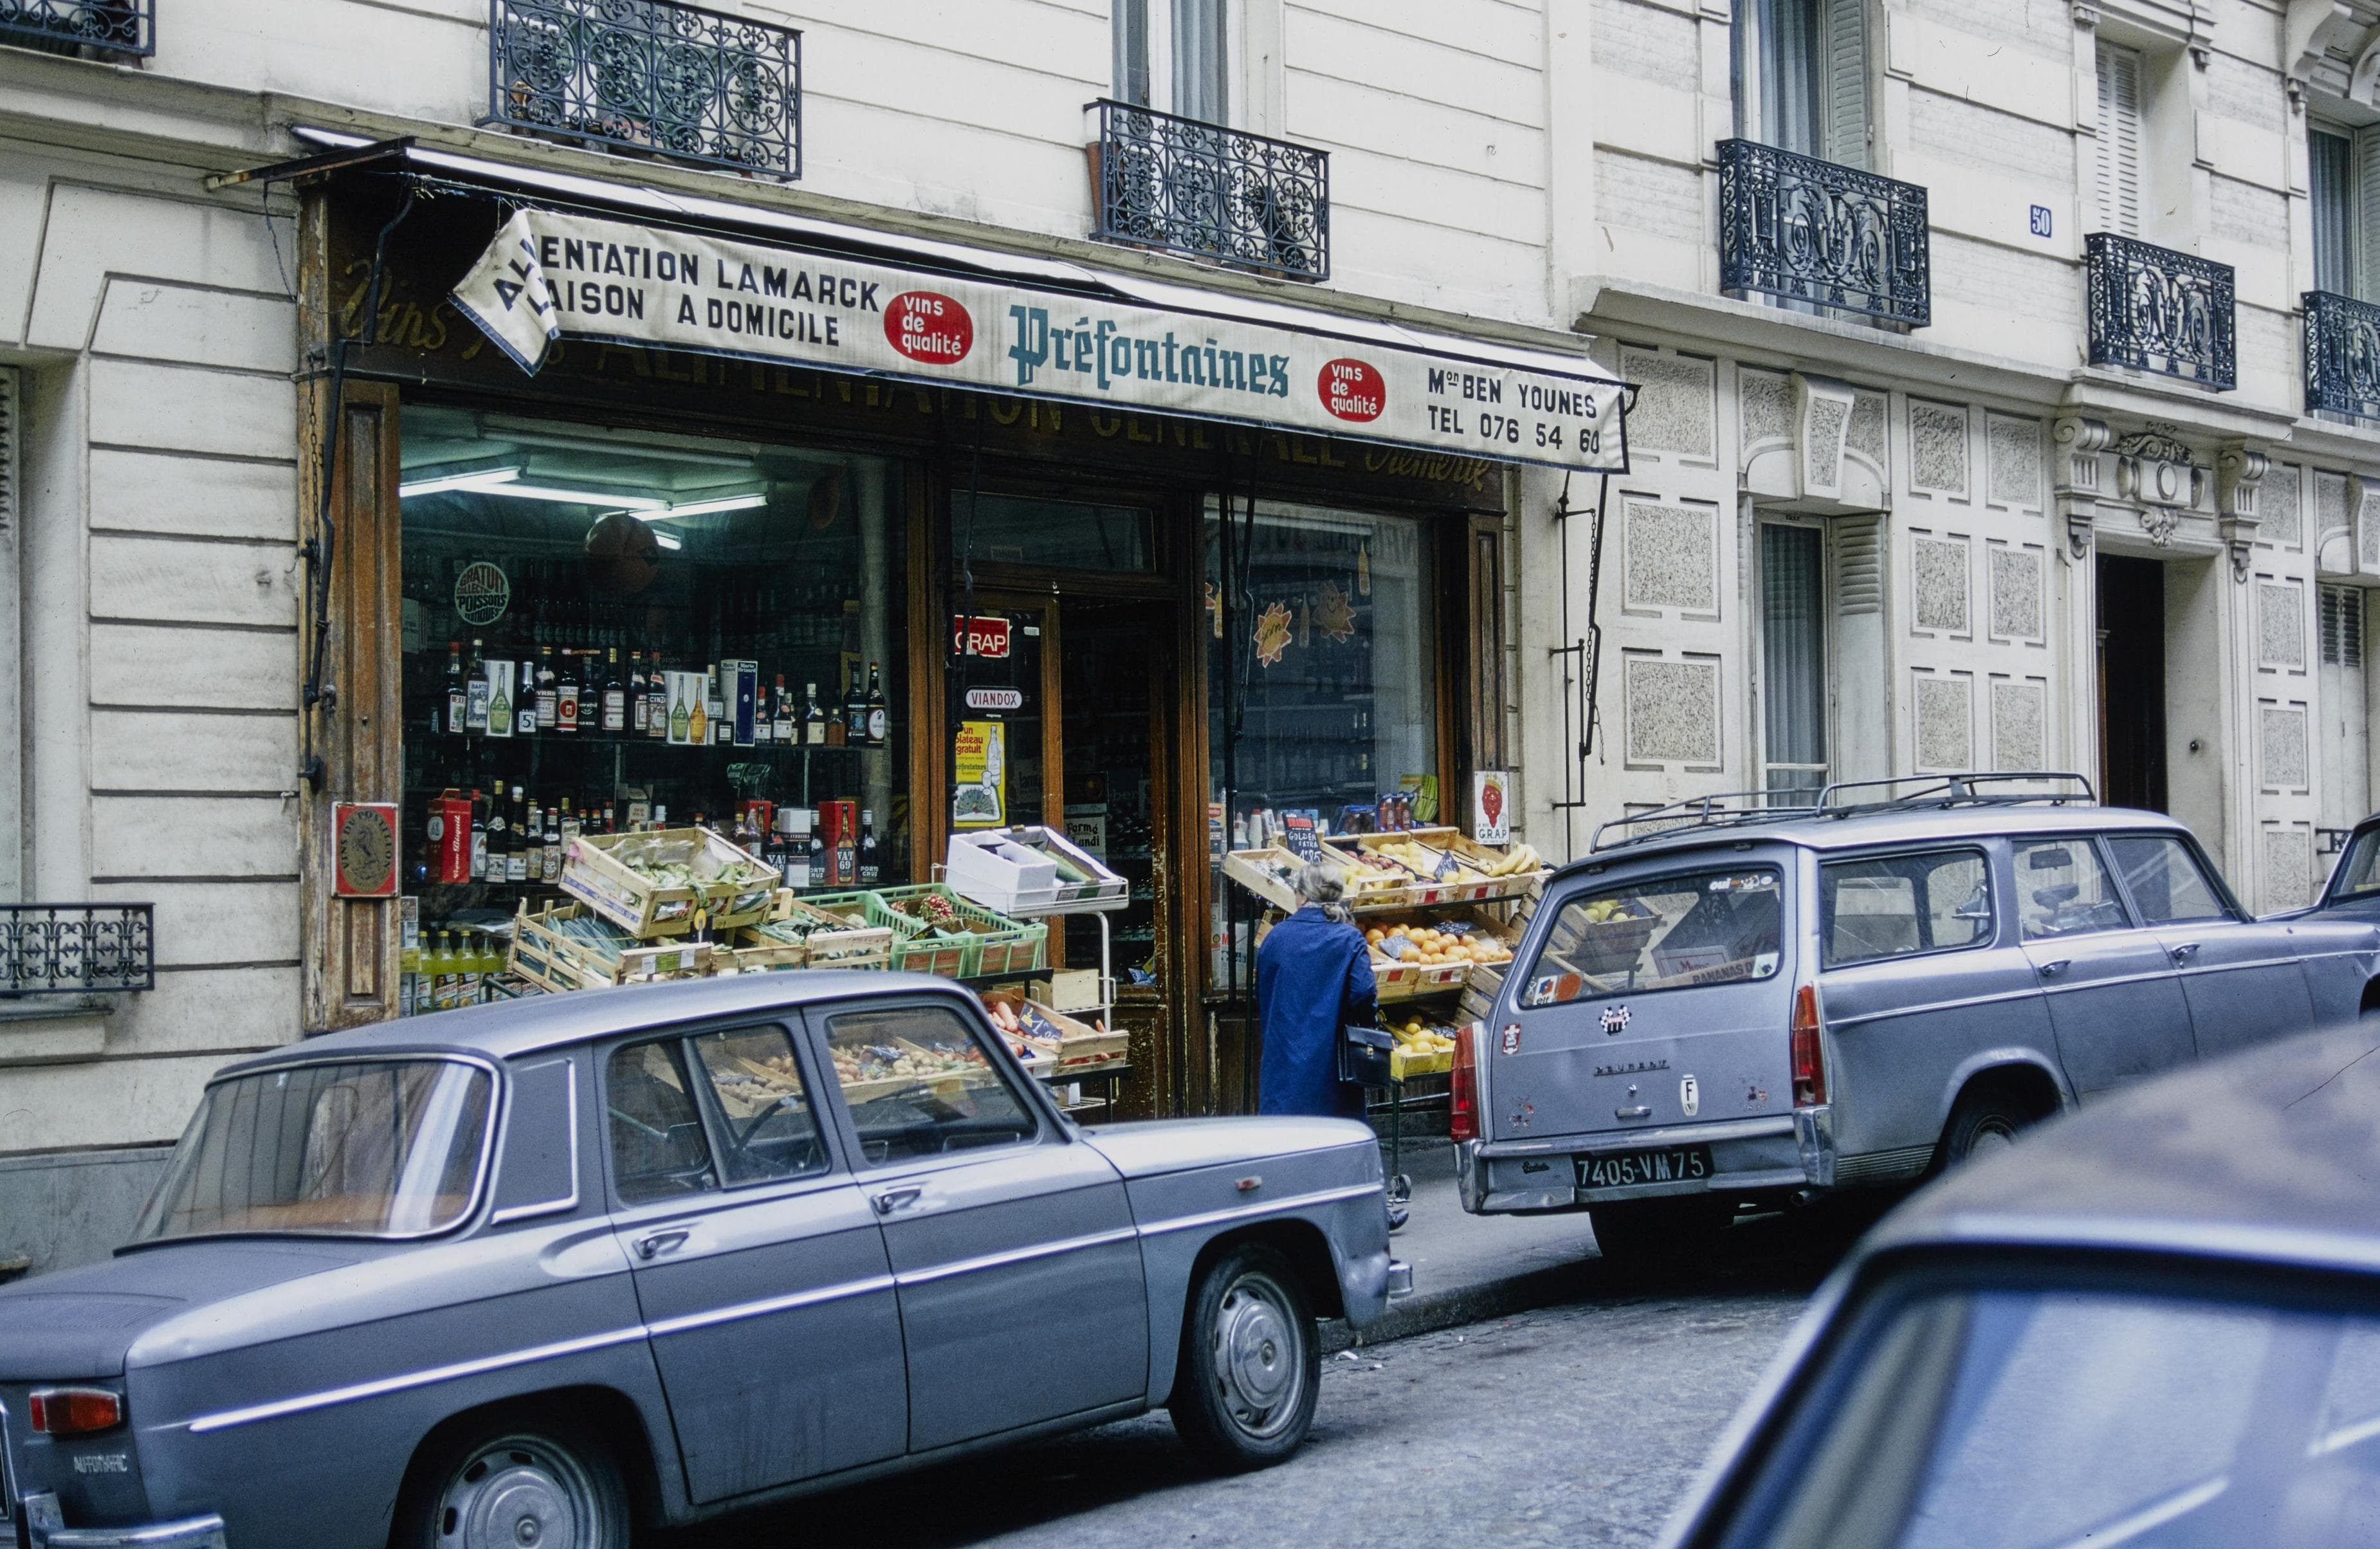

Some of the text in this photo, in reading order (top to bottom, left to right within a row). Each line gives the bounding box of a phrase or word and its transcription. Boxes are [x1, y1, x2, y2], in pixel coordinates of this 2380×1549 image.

[2031, 206, 2051, 235] 50
[717, 258, 880, 313] LAMARCK
[902, 294, 944, 317] vins
[677, 293, 697, 326] A
[708, 297, 840, 347] DOMICILE
[902, 315, 925, 333] de
[902, 331, 962, 357] qualité
[1007, 304, 1290, 399] Préfontaines
[1331, 363, 1363, 382] vins
[1331, 377, 1350, 396] de
[1463, 374, 1503, 405] BEN
[1517, 382, 1598, 419] YOUNES
[1331, 394, 1378, 416] qualité
[1427, 405, 1465, 435] TEL
[1479, 412, 1520, 445] 076
[1535, 422, 1564, 450] 54
[971, 692, 1017, 706] VIANDOX
[957, 744, 982, 755] gratuit
[1066, 823, 1098, 834] Fermé
[1288, 831, 1317, 841] GOLDEN
[837, 850, 854, 861] VAT
[839, 860, 851, 870] 69
[1692, 964, 1744, 985] BANANAS
[1685, 1081, 1694, 1101] F
